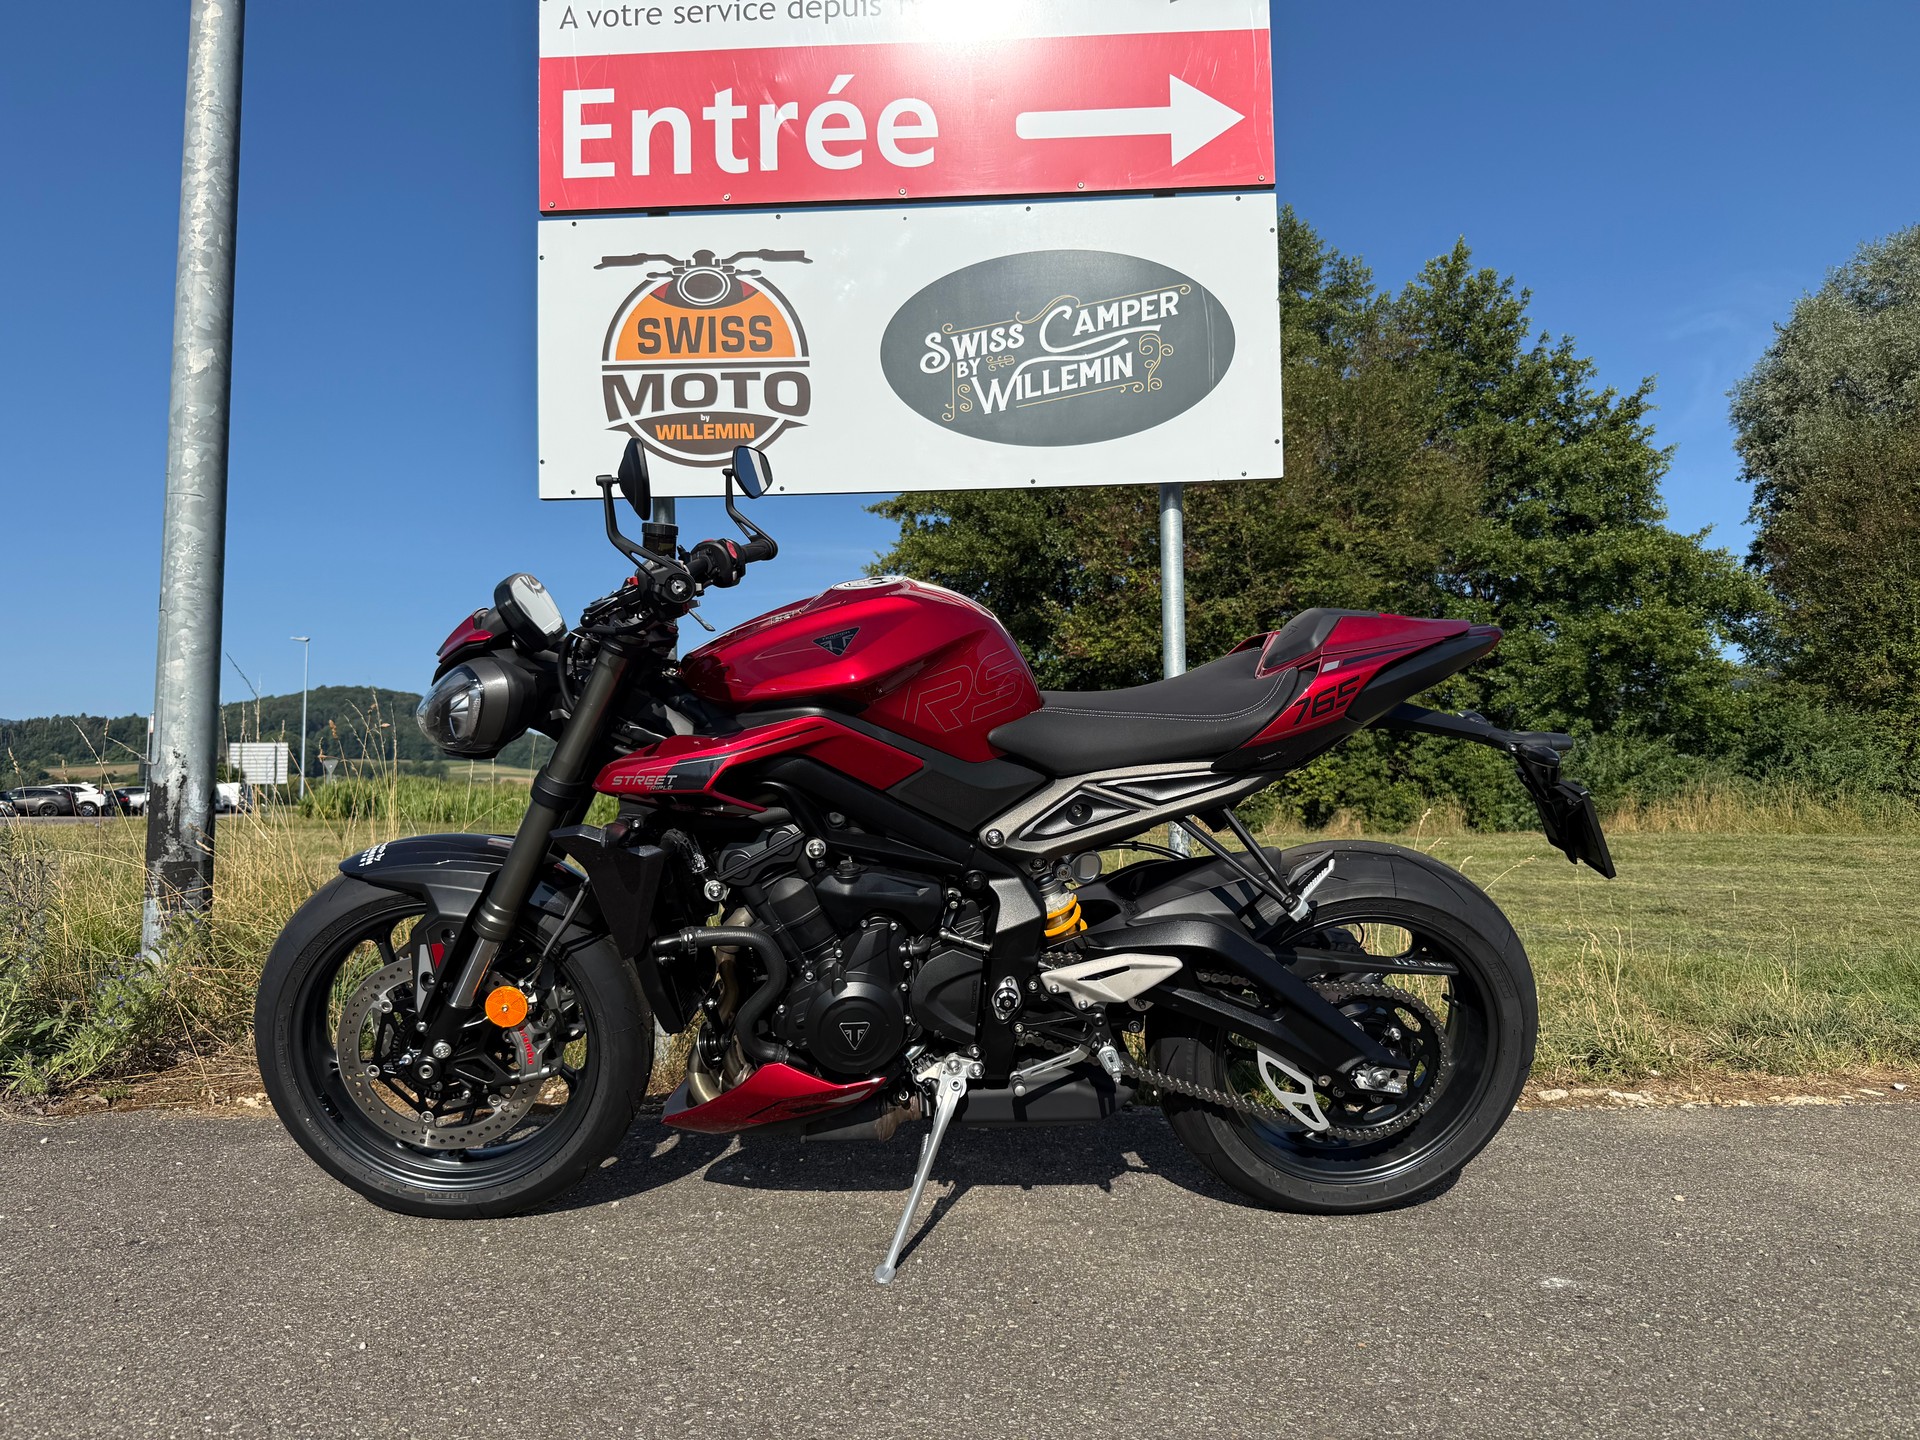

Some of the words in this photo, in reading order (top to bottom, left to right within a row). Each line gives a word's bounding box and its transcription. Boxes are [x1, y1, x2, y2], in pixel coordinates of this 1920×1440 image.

[586, 3, 663, 29] votre
[673, 0, 776, 25] service
[787, 0, 882, 25] depuis
[563, 74, 939, 179] Entrée
[637, 315, 773, 355] SWISS
[919, 322, 1025, 374] SWISS
[1039, 290, 1180, 353] CAMPER
[956, 357, 981, 379] BY
[970, 338, 1134, 415] WILLEMIN
[602, 371, 811, 423] MOTO
[700, 414, 710, 422] by
[655, 423, 755, 441] WILLEMIN
[902, 647, 1025, 733] RS
[1292, 675, 1360, 726] 765
[611, 774, 678, 786] STREET
